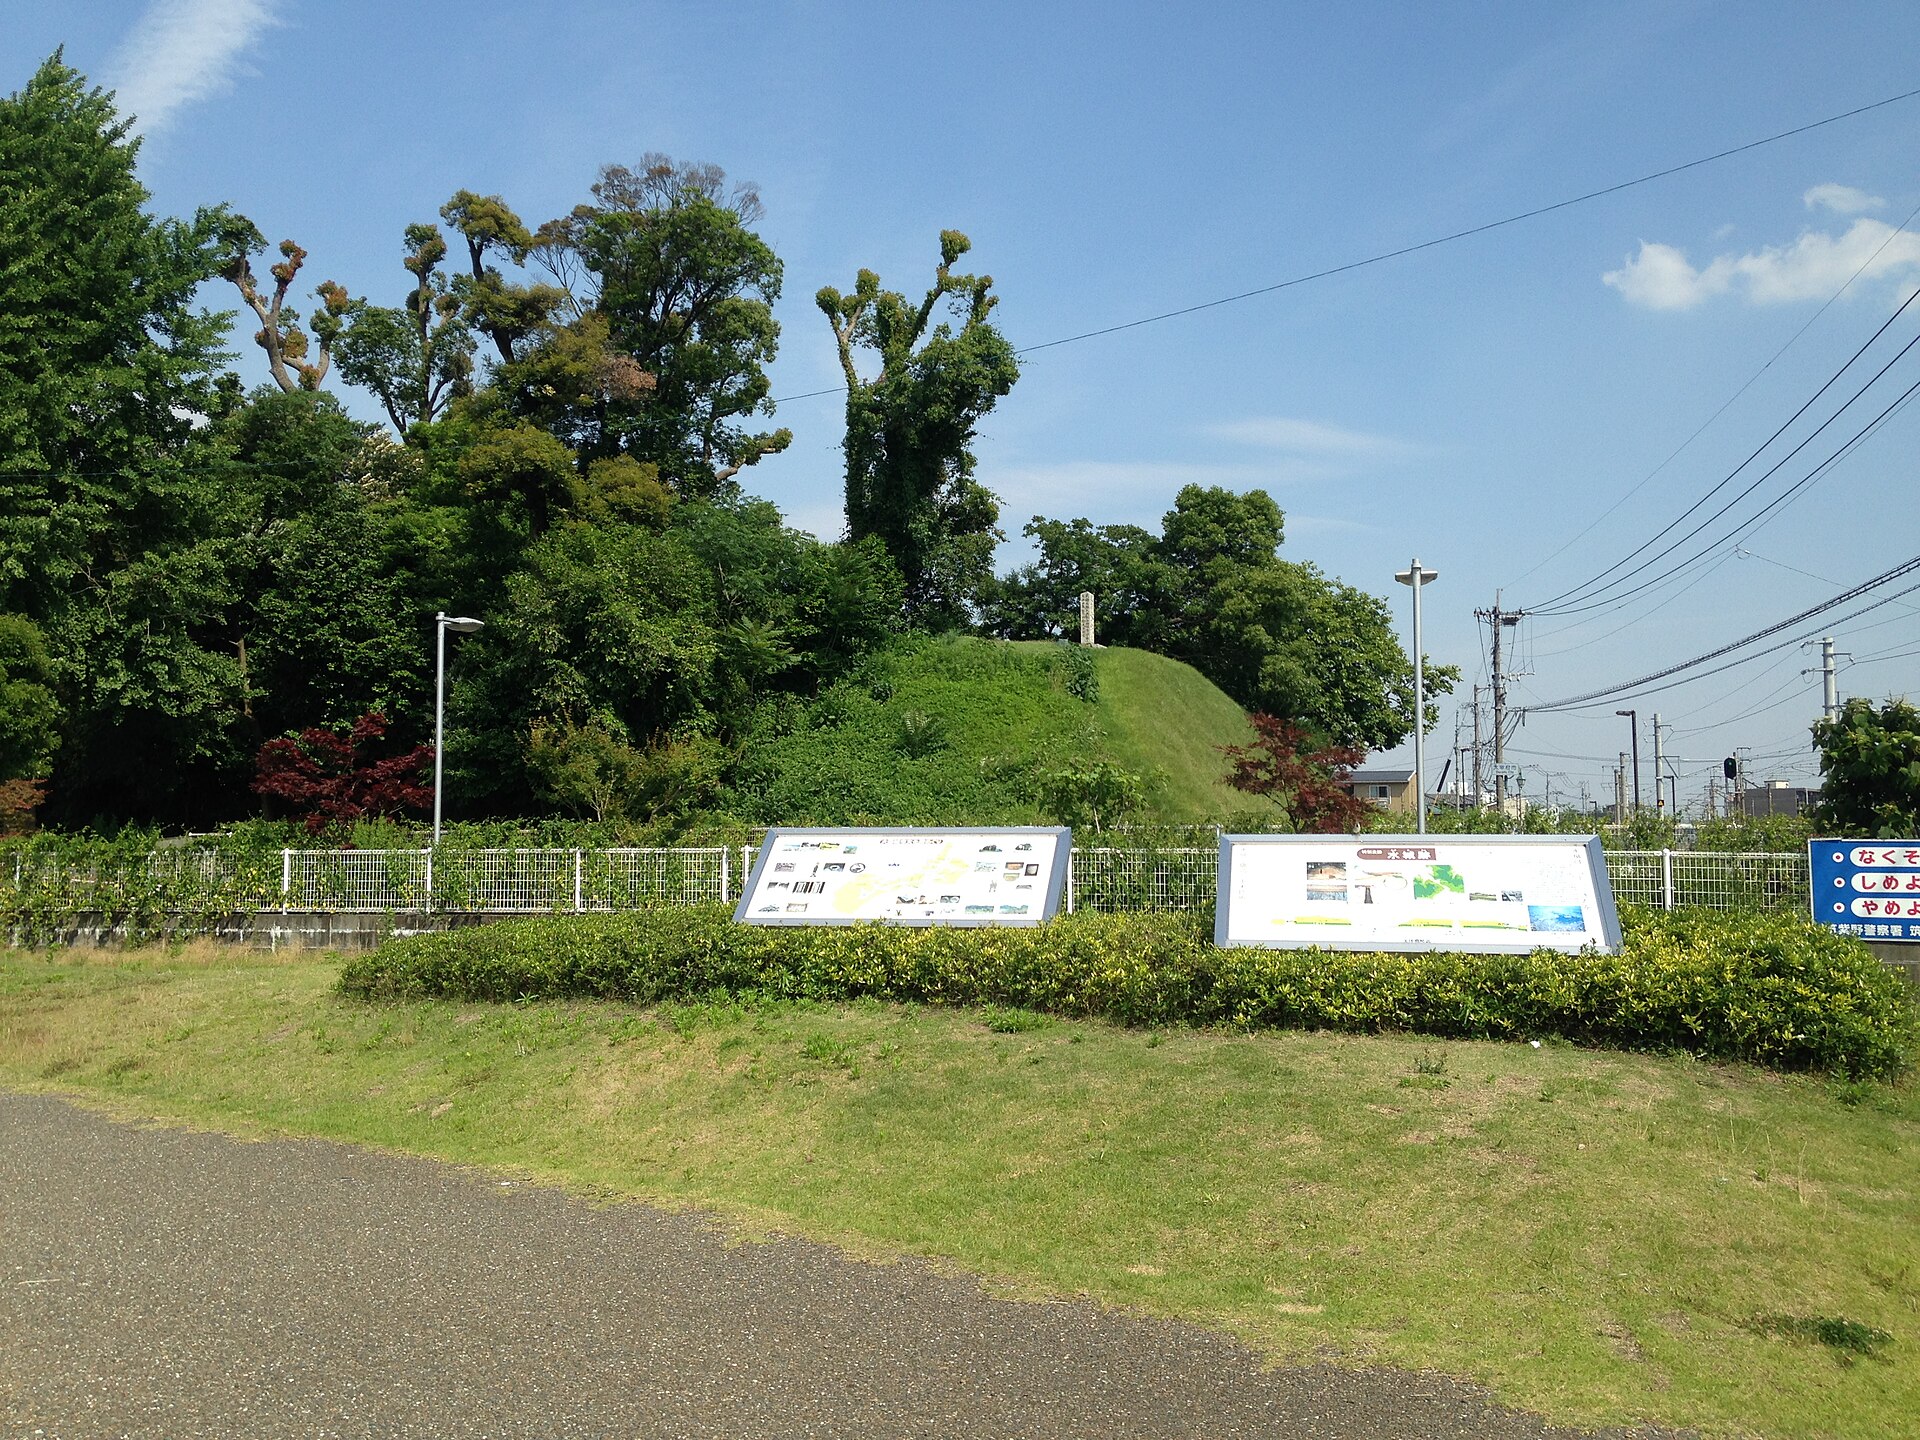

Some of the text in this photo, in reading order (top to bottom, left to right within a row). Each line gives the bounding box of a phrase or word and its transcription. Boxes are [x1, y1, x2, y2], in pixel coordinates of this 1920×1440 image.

[1858, 849, 1920, 865] なくそ
[1861, 875, 1920, 890] しめよ
[1862, 900, 1920, 916] やめよ
